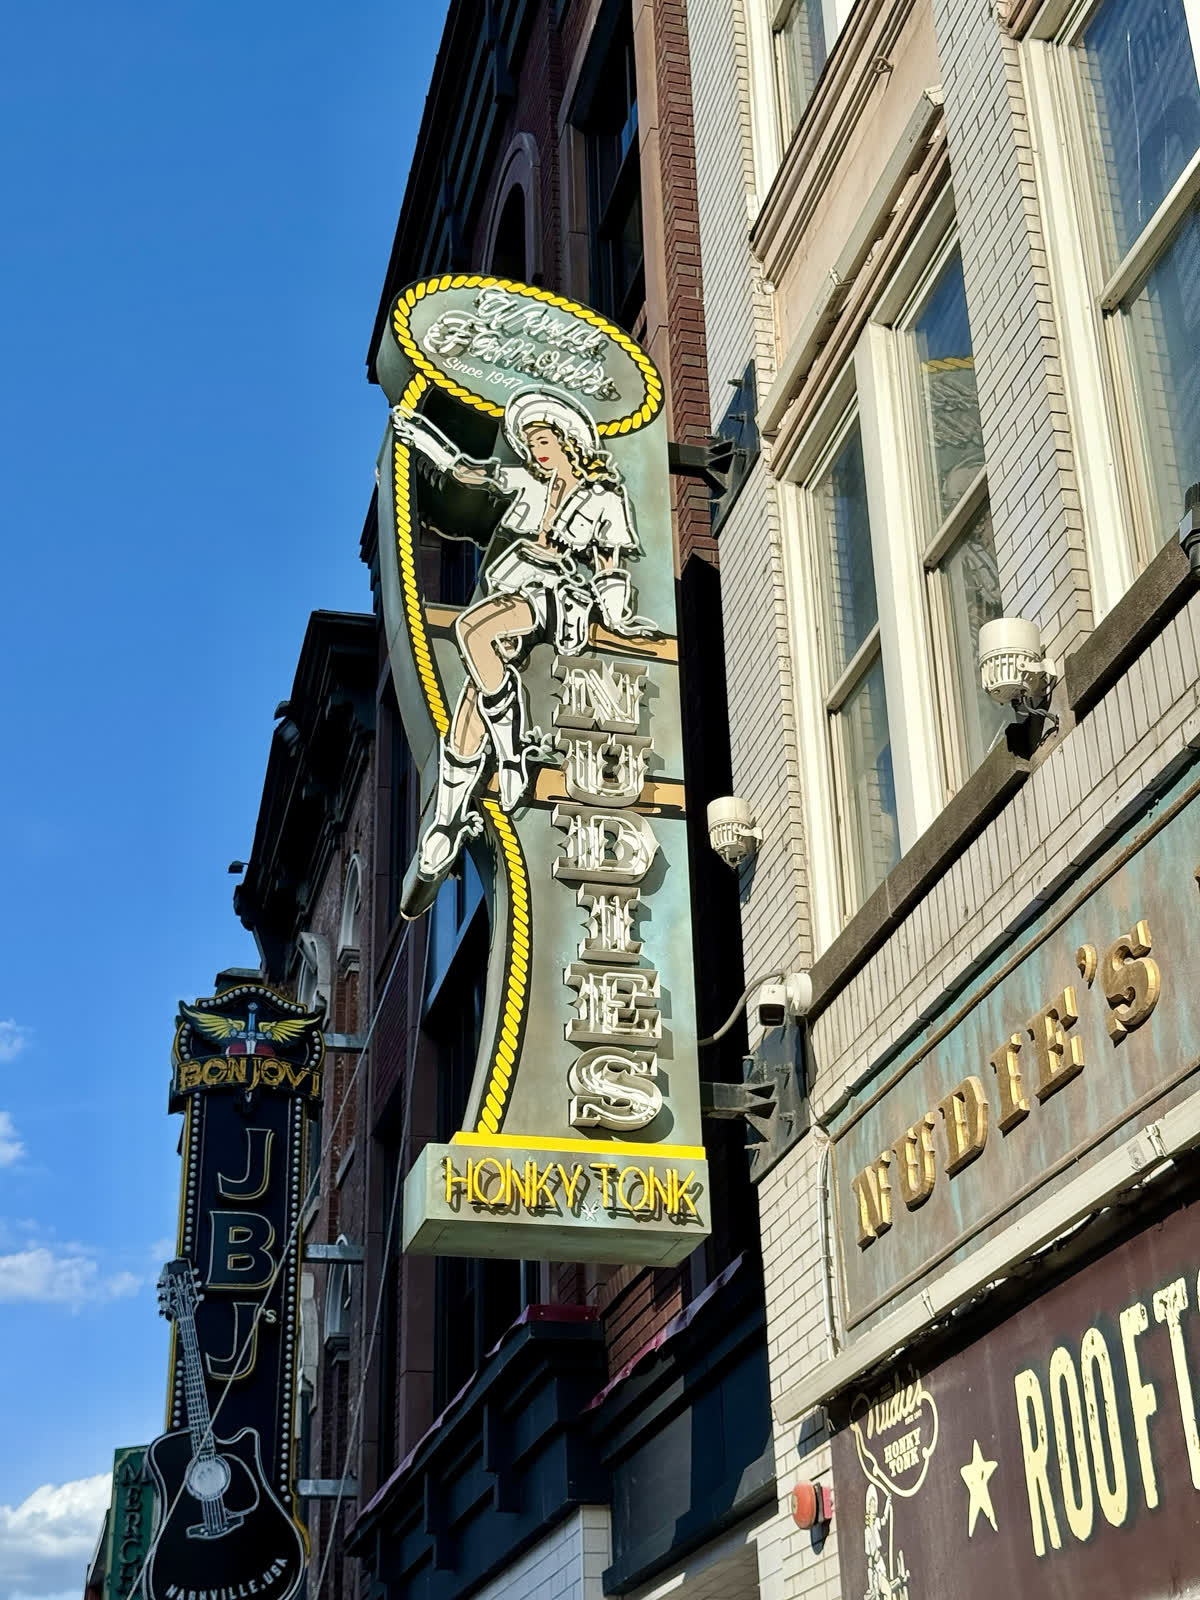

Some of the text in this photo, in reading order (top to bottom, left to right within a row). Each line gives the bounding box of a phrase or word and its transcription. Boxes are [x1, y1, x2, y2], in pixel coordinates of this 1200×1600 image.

[442, 357, 523, 390] Since 1947
[551, 655, 664, 1132] NUDIES
[179, 1057, 321, 1097] BON JOVI
[851, 919, 1161, 1251] NUDIE'S
[445, 1157, 698, 1216] HONKY TONK
[1014, 1268, 1200, 1556] ROOFT
[883, 1426, 921, 1464] HONKY
[888, 1446, 920, 1478] TONK
[262, 1557, 288, 1585] USA
